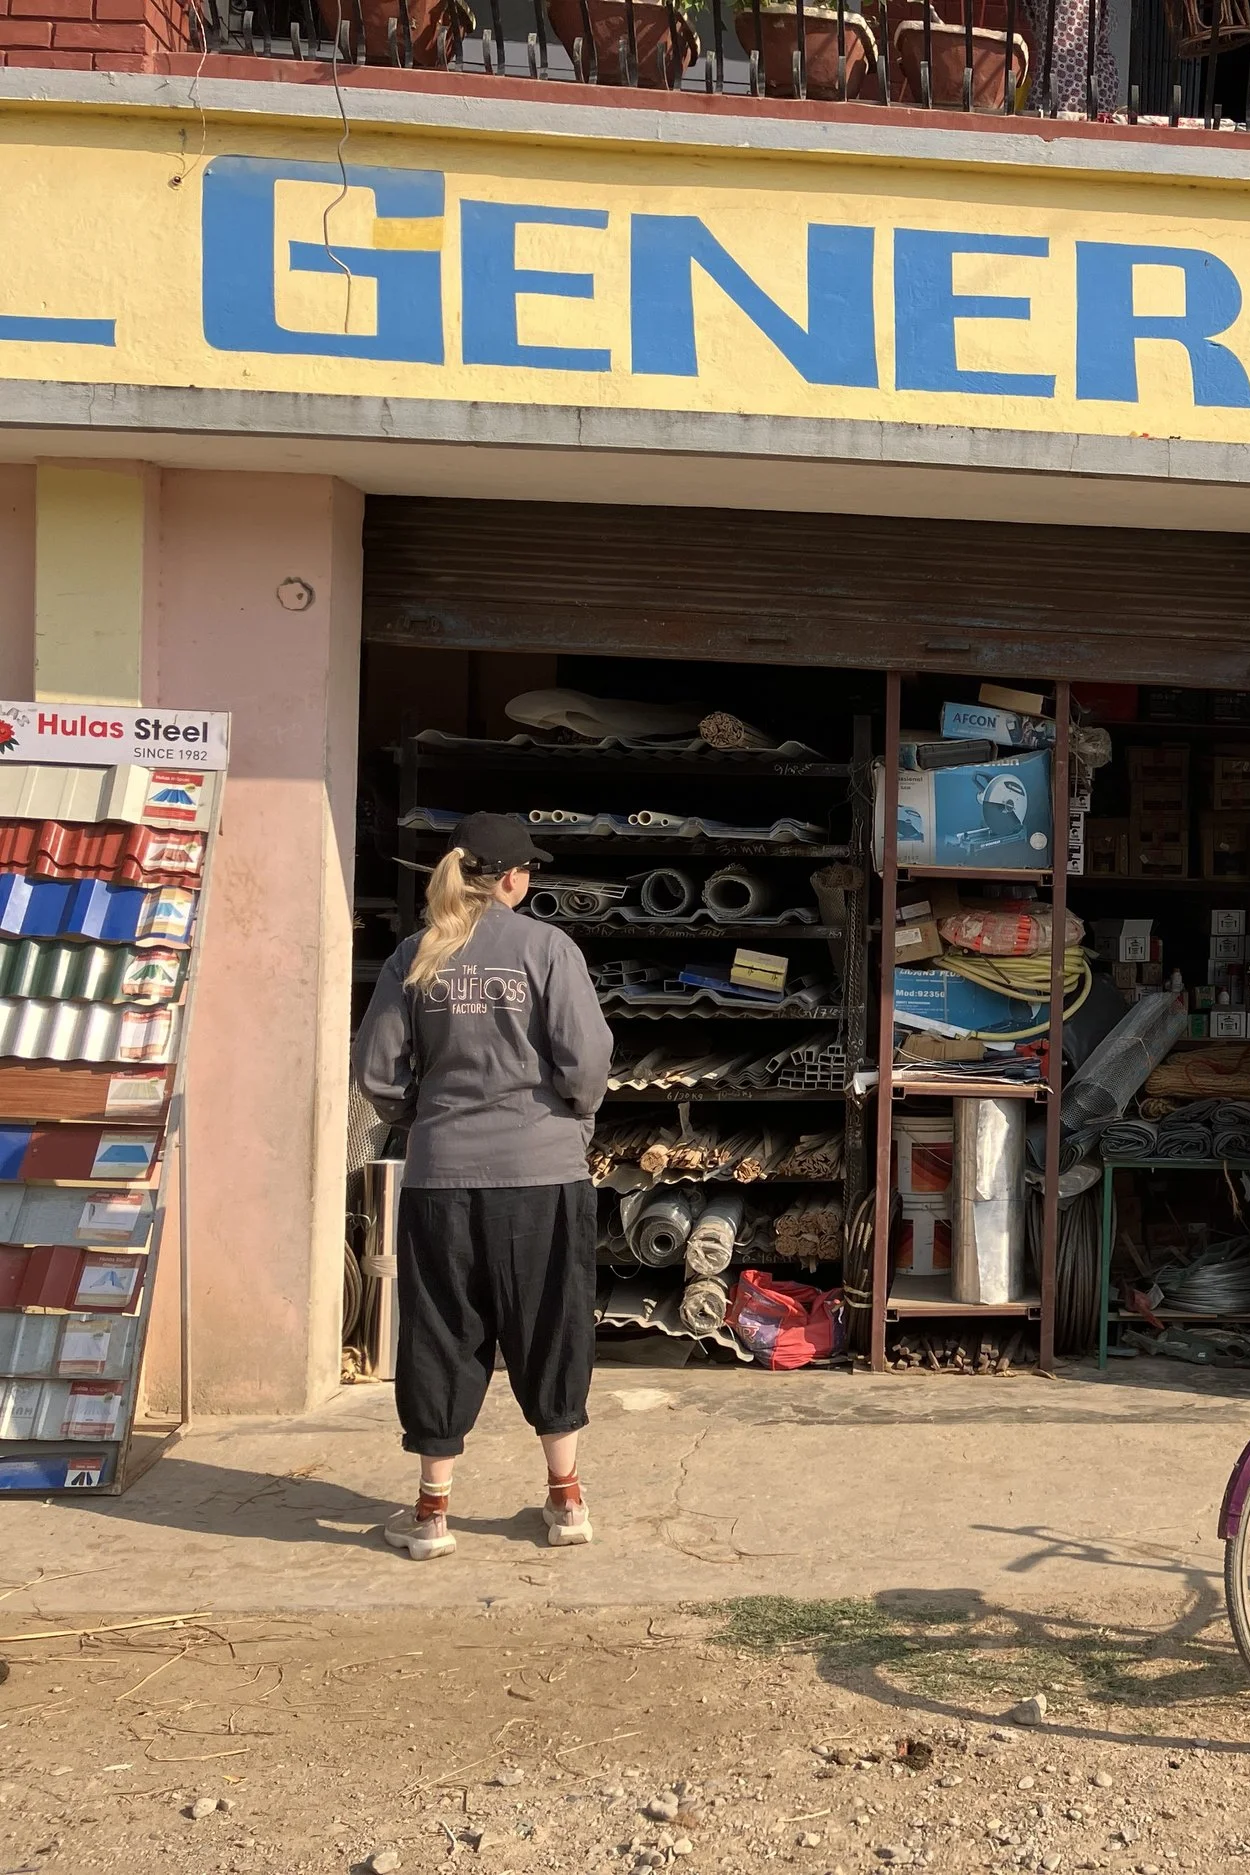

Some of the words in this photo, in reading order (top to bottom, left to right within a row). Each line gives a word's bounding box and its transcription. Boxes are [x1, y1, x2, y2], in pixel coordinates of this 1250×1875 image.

[952, 712, 997, 728] AFCON
[37, 712, 125, 739] Hulas
[134, 717, 209, 744] Steel
[133, 747, 174, 760] SINCE
[179, 749, 208, 762] 1982
[461, 964, 478, 976] THE
[451, 1002, 488, 1015] FACTORY
